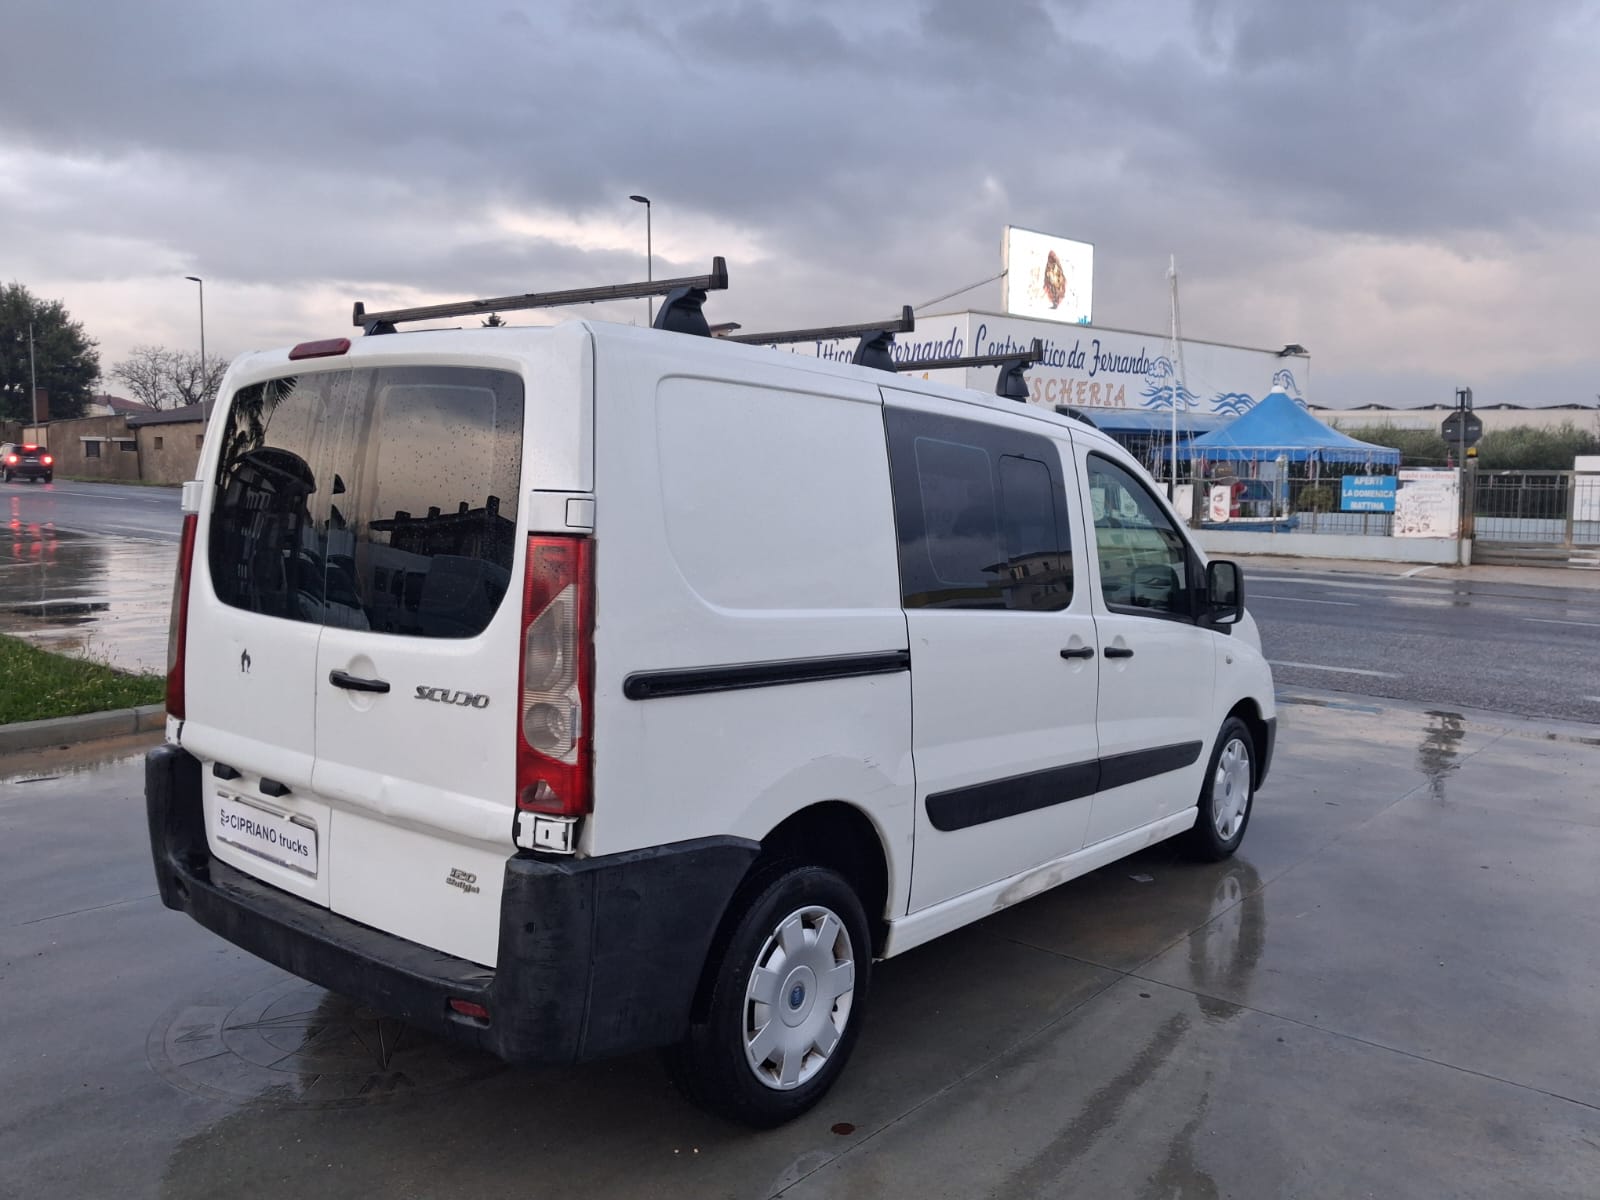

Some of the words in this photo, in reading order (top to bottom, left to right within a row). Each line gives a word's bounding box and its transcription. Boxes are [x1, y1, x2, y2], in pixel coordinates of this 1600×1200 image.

[888, 327, 963, 363] ernando
[1067, 339, 1085, 370] da
[1089, 339, 1150, 377] Fernando
[1025, 376, 1126, 407] SCHERIA
[1343, 489, 1353, 497] LA
[414, 685, 490, 709] SCUDO
[230, 814, 277, 843] CIPRIANO
[279, 833, 309, 857] trucks
